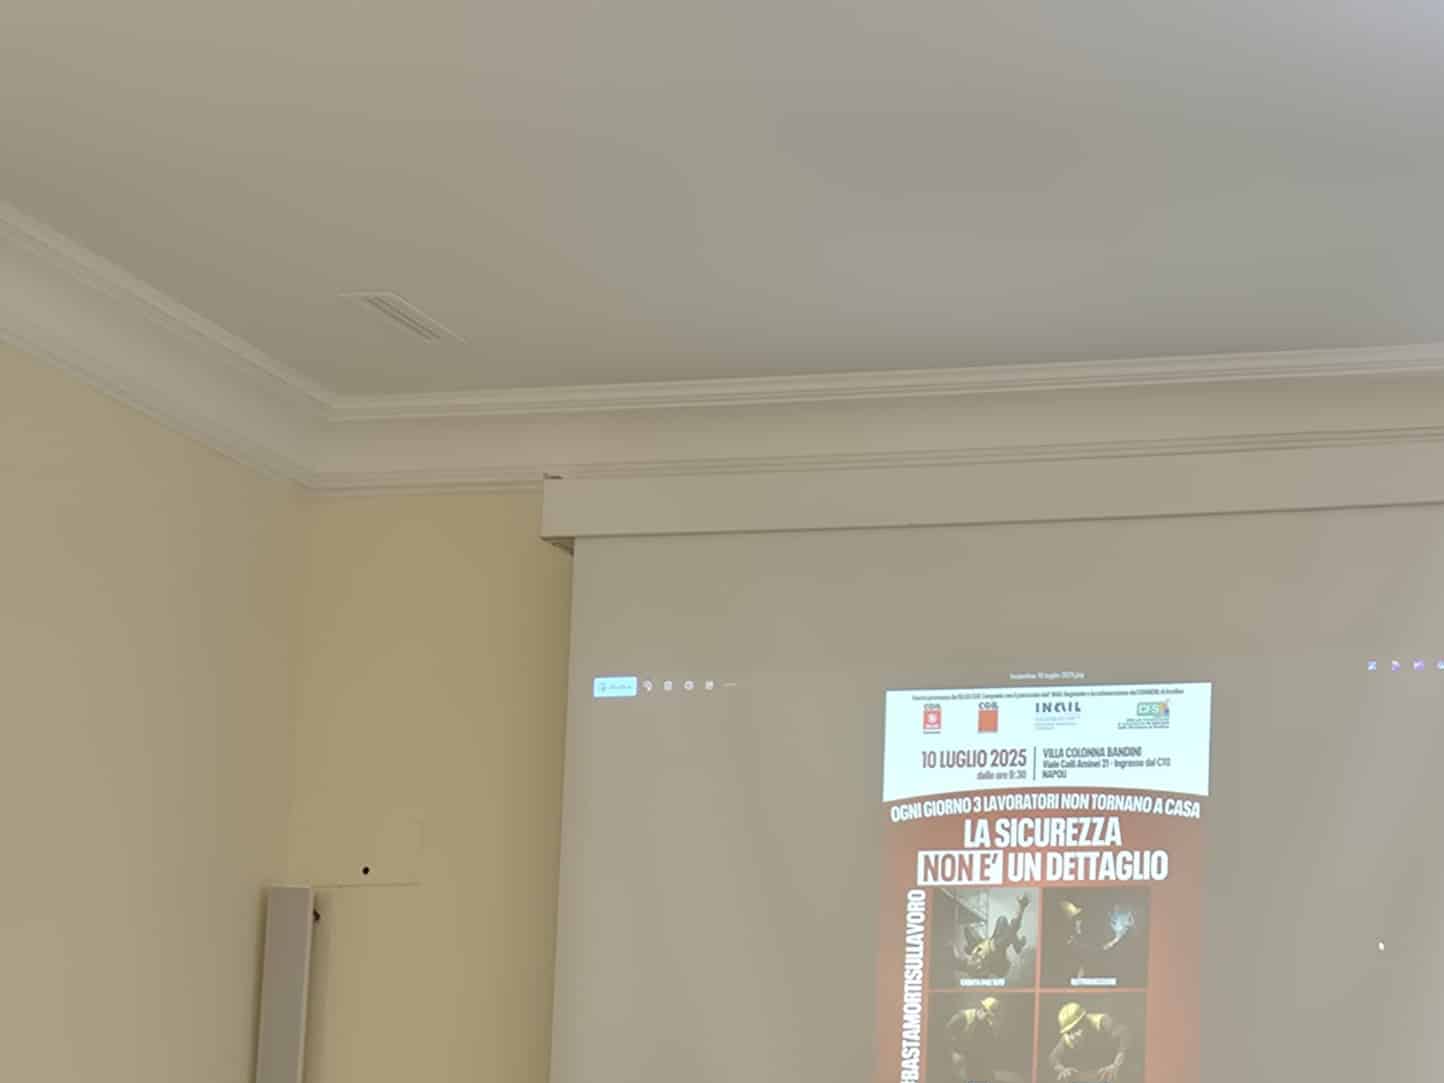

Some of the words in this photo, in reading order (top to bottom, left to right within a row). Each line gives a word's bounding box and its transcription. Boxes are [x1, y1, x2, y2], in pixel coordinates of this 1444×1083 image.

[921, 750, 937, 769] 10
[939, 749, 988, 769] LUGLIO
[990, 747, 1027, 767] 2025
[1043, 747, 1064, 758] VILLA
[1065, 747, 1105, 758] COLONNA
[1042, 769, 1067, 778] NAPOLI
[890, 802, 923, 823] OGNI
[923, 797, 972, 818] GIORNO
[973, 796, 982, 813] 3
[983, 793, 1059, 812] LAVORATORI
[1061, 792, 1089, 810] NON
[1091, 793, 1151, 814] TORNANO
[1152, 797, 1164, 814] A
[1165, 798, 1201, 819] CASA
[963, 817, 992, 849] LA
[995, 815, 1123, 848] SICUREZZA
[923, 853, 973, 883] NON
[1007, 851, 1042, 882] UN
[1046, 849, 1169, 881] DETTAGLIO
